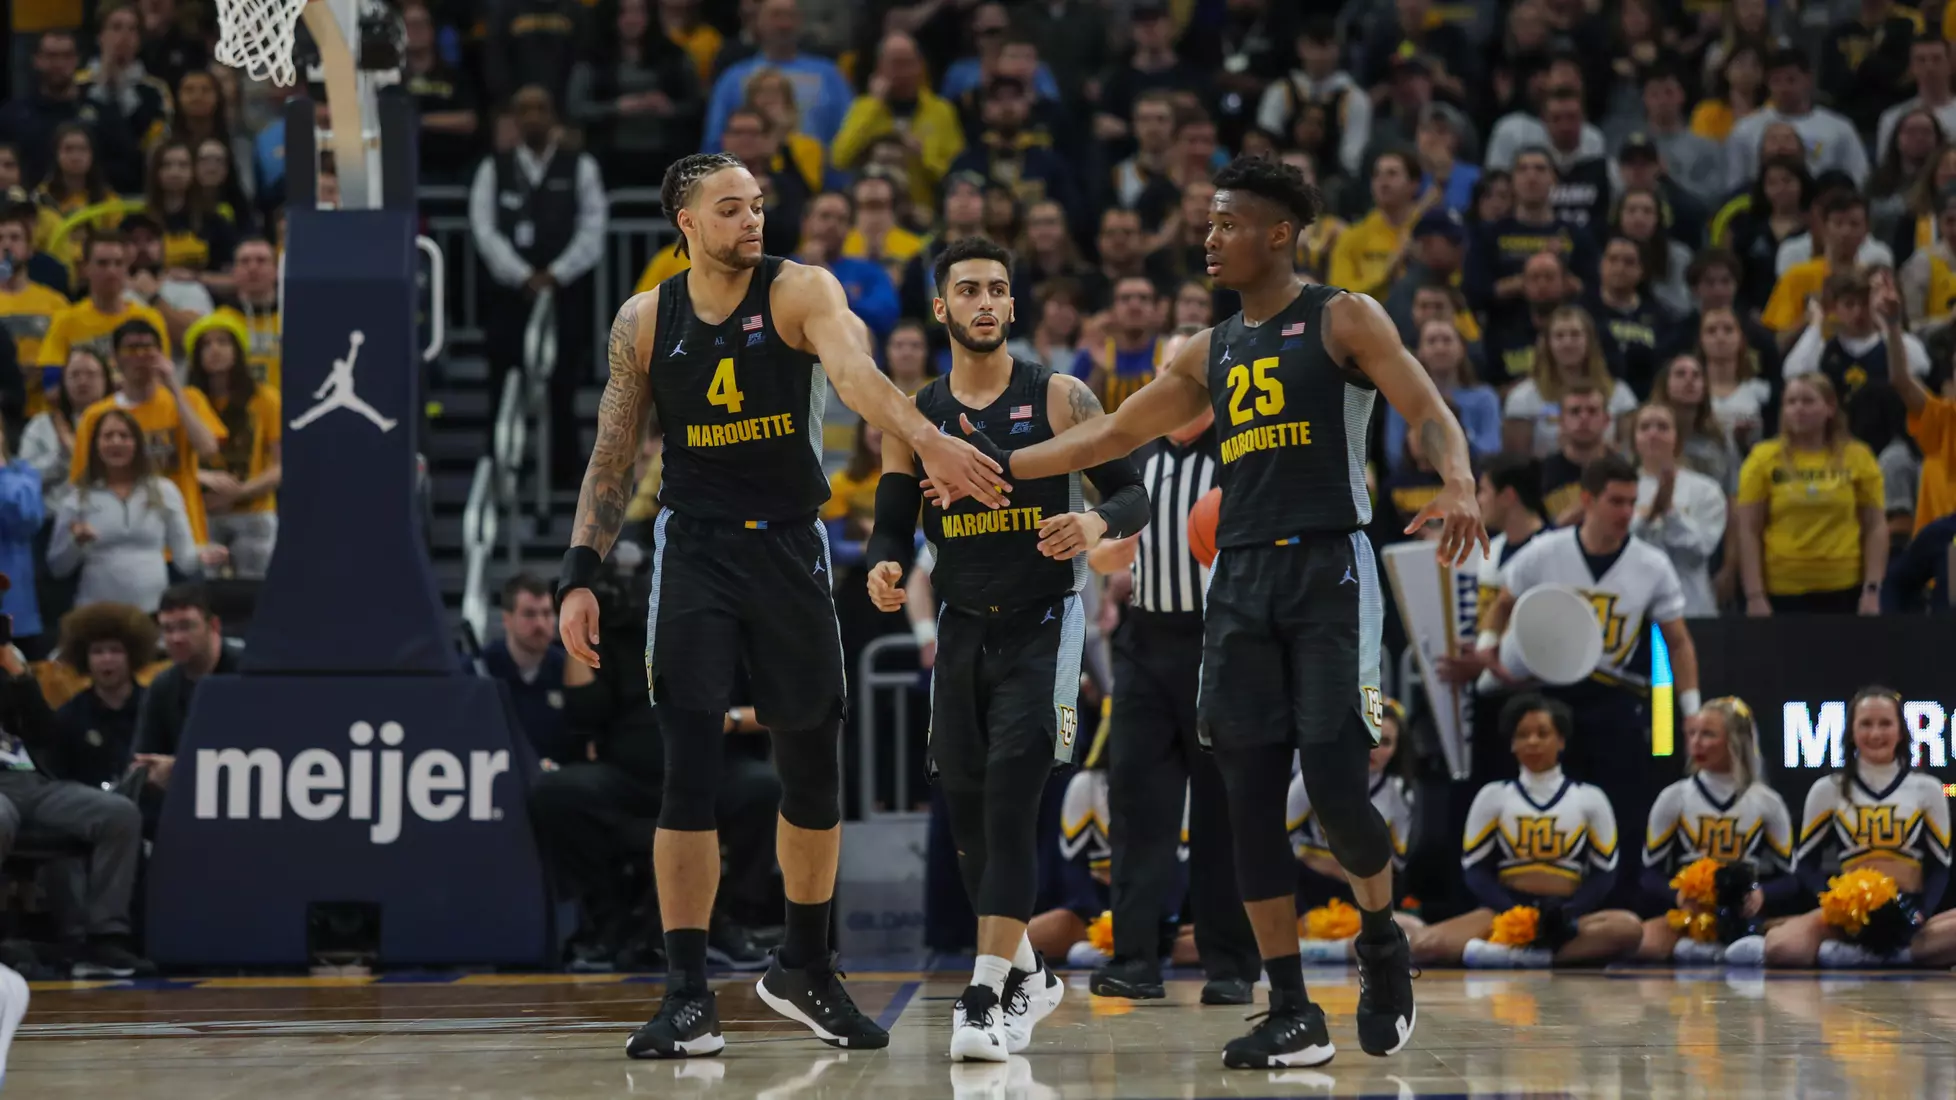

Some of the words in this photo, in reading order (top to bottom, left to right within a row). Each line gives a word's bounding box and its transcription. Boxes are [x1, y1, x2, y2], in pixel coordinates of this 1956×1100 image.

[706, 357, 744, 414] 4
[1226, 356, 1286, 427] 25
[687, 412, 795, 448] MARQUETTE
[1220, 421, 1312, 465] MARQUETTE
[941, 506, 1043, 539] MARQUETTE
[1059, 704, 1077, 748] MU
[1783, 701, 1956, 768] MR
[194, 721, 510, 844] meijer
[1515, 815, 1566, 861] MU
[1697, 814, 1746, 861] MU
[1856, 804, 1906, 850] MU
